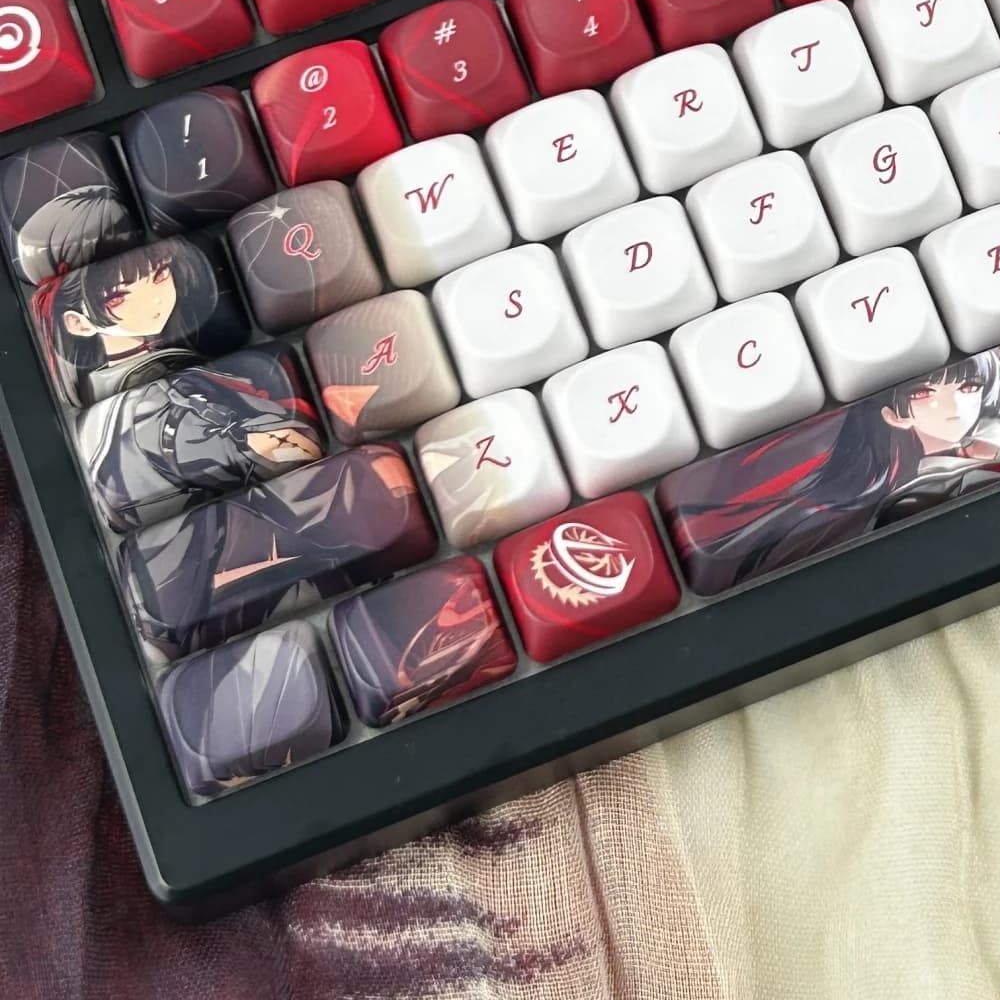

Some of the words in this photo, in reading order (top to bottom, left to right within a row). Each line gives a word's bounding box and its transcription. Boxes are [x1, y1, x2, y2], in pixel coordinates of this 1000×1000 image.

[433, 18, 457, 46] #
[583, 15, 599, 37] 4
[453, 60, 468, 83] 3
[790, 40, 821, 73] T
[299, 65, 329, 93] @
[322, 106, 337, 130] 2
[673, 88, 704, 118] R
[183, 113, 192, 143] !
[551, 133, 578, 164] E
[872, 144, 898, 185] G
[404, 173, 455, 214] W
[749, 192, 775, 225] F
[281, 222, 323, 262] Q
[624, 241, 653, 273] D
[504, 289, 523, 319] S
[850, 286, 890, 323] V
[360, 331, 399, 376] A
[737, 339, 762, 369] C
[607, 384, 640, 424] X
[475, 435, 512, 470] Z
